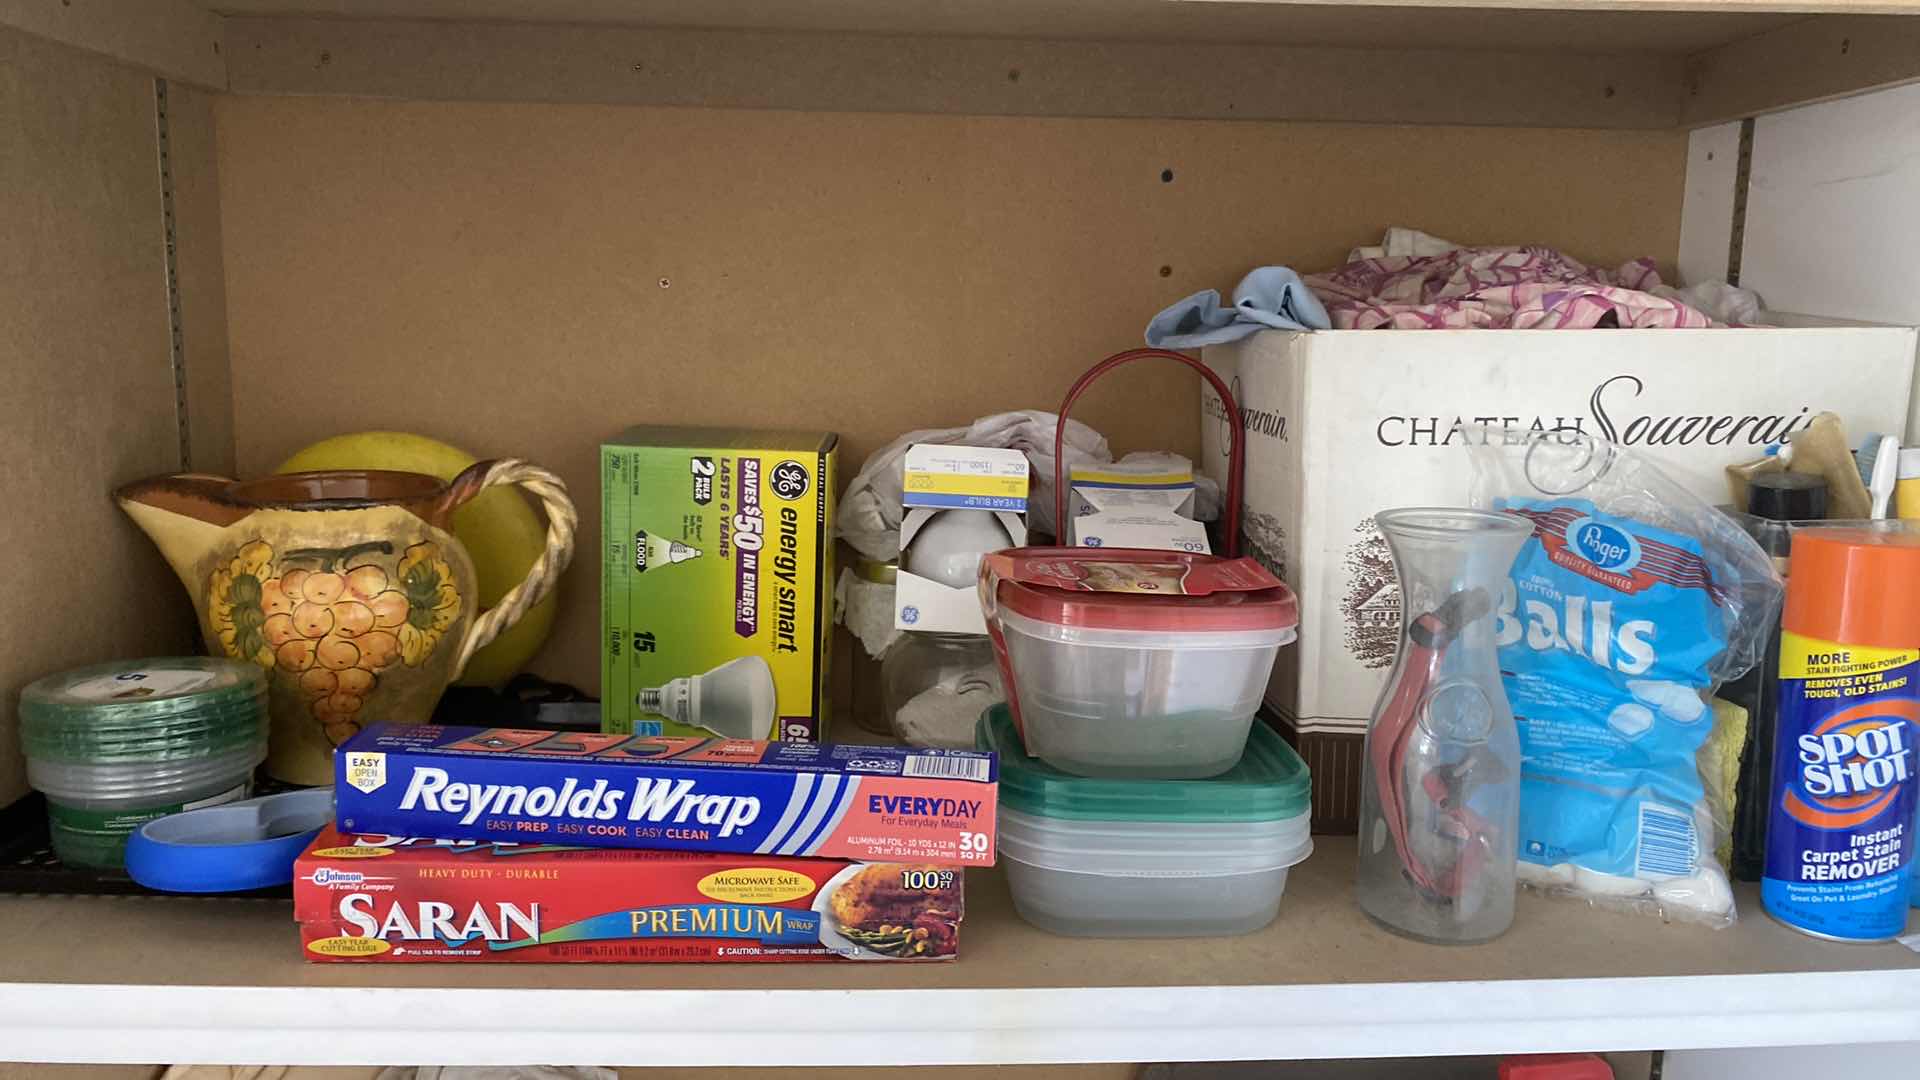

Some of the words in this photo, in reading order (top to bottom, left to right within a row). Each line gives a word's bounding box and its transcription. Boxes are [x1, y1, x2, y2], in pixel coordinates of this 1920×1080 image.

[1377, 416, 1583, 446] CHATEAU
[691, 458, 716, 478] 2
[720, 457, 731, 500] LASTS
[694, 477, 702, 500] PACK
[703, 477, 711, 499] BULB
[743, 459, 758, 506] SAVES
[720, 503, 730, 512] 6
[719, 516, 730, 558] YEARS
[733, 503, 764, 550] $50
[636, 537, 646, 566] FLOOD
[774, 507, 798, 585] energy
[1583, 526, 1627, 565] Kroger
[742, 553, 756, 571] IN
[1587, 566, 1633, 591] GUARANTEED
[741, 572, 755, 626] ENERGY
[1519, 580, 1563, 602] COTTON
[777, 586, 799, 654] smart
[633, 631, 656, 653] 15
[1807, 652, 1850, 665] MORE
[1807, 666, 1830, 675] STAIN
[1832, 663, 1876, 674] FIGHTING
[1876, 655, 1908, 668] POWER
[1805, 677, 1853, 689] REMOVES
[1855, 673, 1883, 684] EVEN
[1843, 685, 1866, 696] OLD
[1868, 676, 1908, 693] STAINS!
[1798, 721, 1907, 764] SPOT
[352, 758, 380, 767] EASY
[354, 768, 378, 777] OPEN
[1804, 749, 1911, 794] SHOT
[357, 777, 376, 787] BOX
[399, 767, 625, 825] Reynolds
[627, 777, 761, 838] Wrap
[869, 794, 982, 819] EVERYDAY
[486, 820, 513, 831] EASY
[516, 822, 549, 832] PREP
[557, 823, 584, 834] EASY
[587, 825, 628, 836] COOK
[635, 827, 663, 837] EASY
[666, 829, 709, 840] CLEAN
[881, 816, 897, 825] For
[898, 816, 939, 829] Everyday
[941, 819, 967, 829] Meals
[847, 836, 887, 846] ALUMINUM
[887, 838, 903, 847] FOIL
[908, 839, 917, 847] 10
[918, 839, 932, 848] YDS
[938, 840, 948, 848] 12
[948, 841, 956, 849] IN
[959, 831, 988, 852] 30
[1851, 824, 1903, 847] Instant
[867, 846, 882, 855] 2.78
[926, 849, 939, 857] 304
[960, 851, 974, 860] SQ
[976, 852, 987, 860] FT
[1802, 848, 1858, 865] Carpet
[1863, 839, 1901, 859] Stain
[324, 869, 362, 883] Johnson
[419, 868, 457, 879] HEAVY
[461, 868, 493, 879] DUTY
[506, 869, 560, 880] DURABLE
[1801, 853, 1900, 880] REMOVER
[335, 884, 360, 892] Family
[361, 884, 394, 892] Company
[714, 876, 775, 886] MICROWAVE
[776, 876, 800, 885] SAFE
[902, 871, 939, 889] 100
[939, 871, 953, 880] SQ
[939, 880, 952, 888] FT
[339, 893, 540, 943] SARAN
[630, 908, 784, 935] PREMIUM
[786, 919, 814, 930] WRAP
[727, 947, 762, 955] CAUTION:
